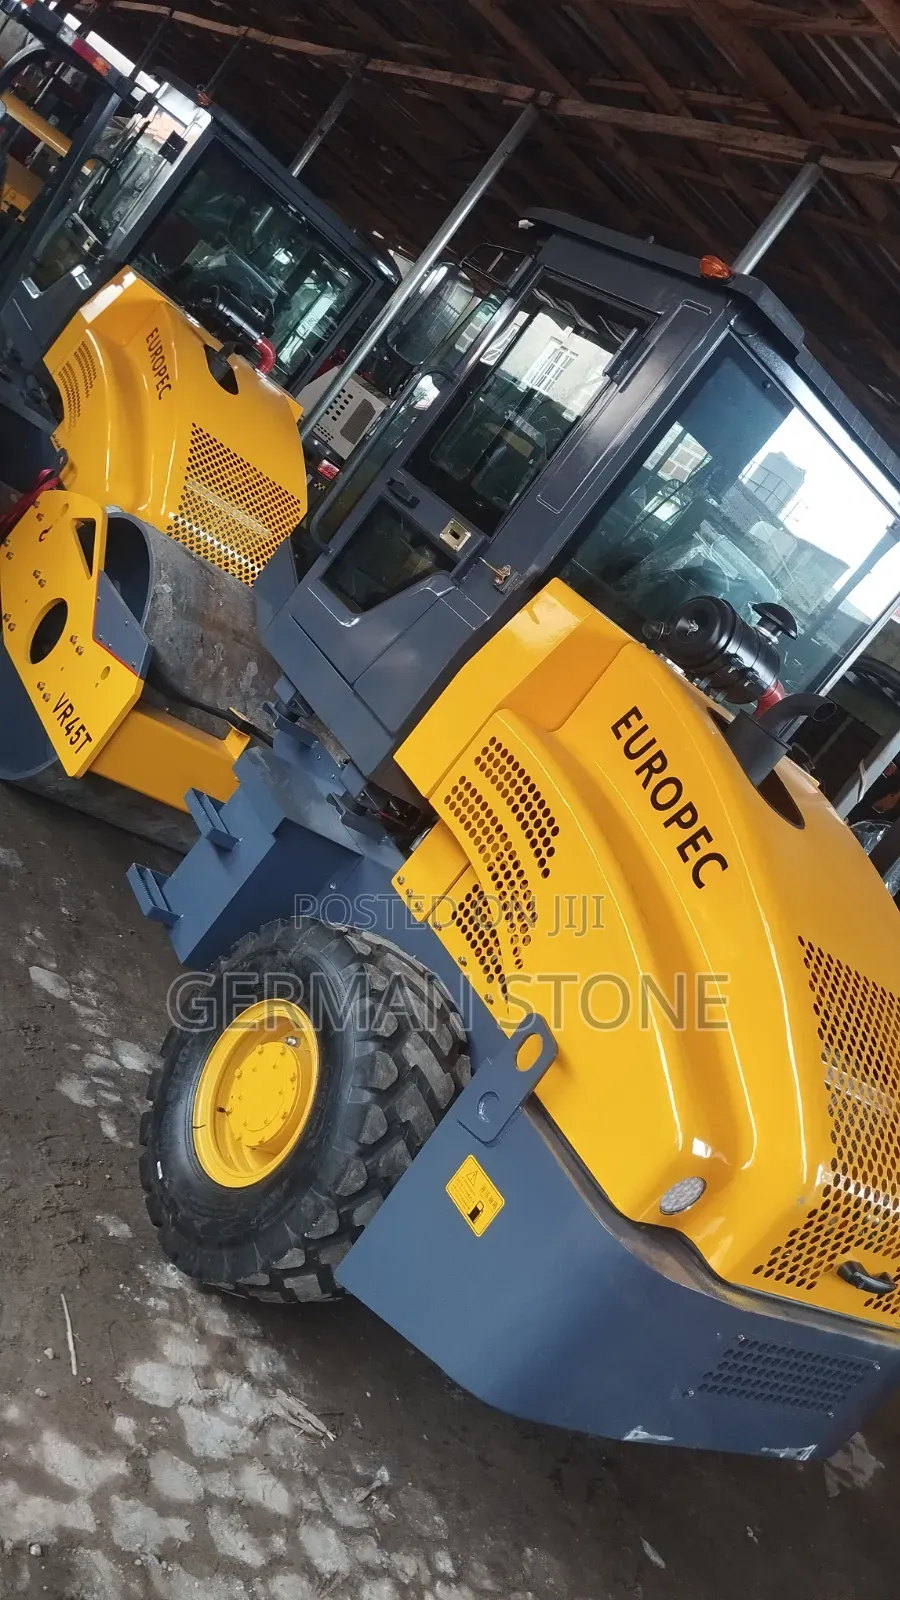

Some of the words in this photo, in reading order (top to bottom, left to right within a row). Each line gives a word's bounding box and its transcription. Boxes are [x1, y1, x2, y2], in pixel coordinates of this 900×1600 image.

[145, 326, 172, 401] EUROPEC
[53, 692, 93, 754] VR45T
[610, 705, 729, 890] EUROPEC
